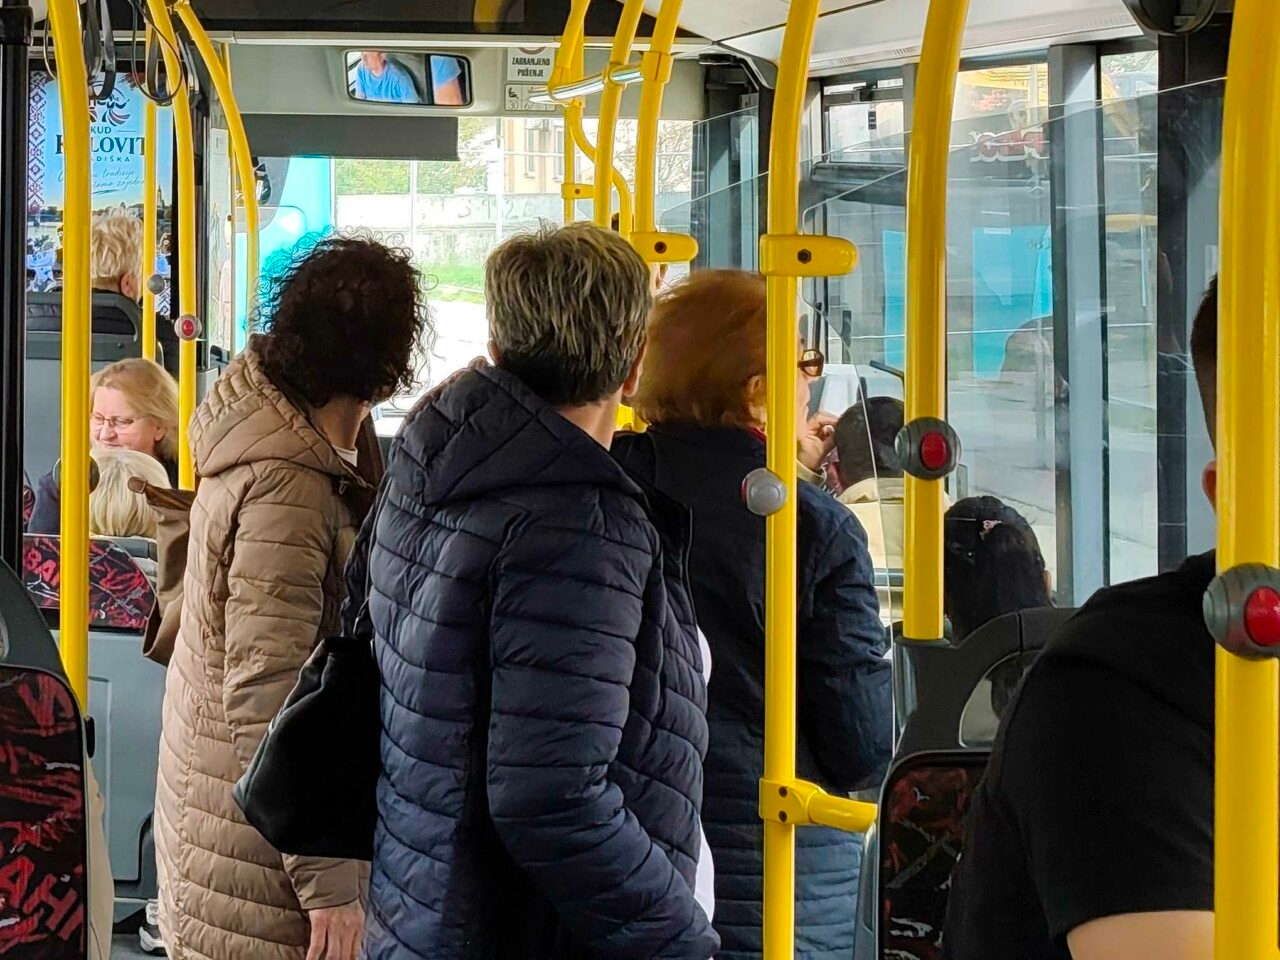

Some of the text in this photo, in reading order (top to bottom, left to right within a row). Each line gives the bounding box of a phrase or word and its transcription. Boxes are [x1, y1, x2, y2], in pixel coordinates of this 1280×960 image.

[512, 57, 551, 66] ZABRANJENO
[517, 68, 544, 77] PUŠENJE
[91, 126, 112, 134] KUD
